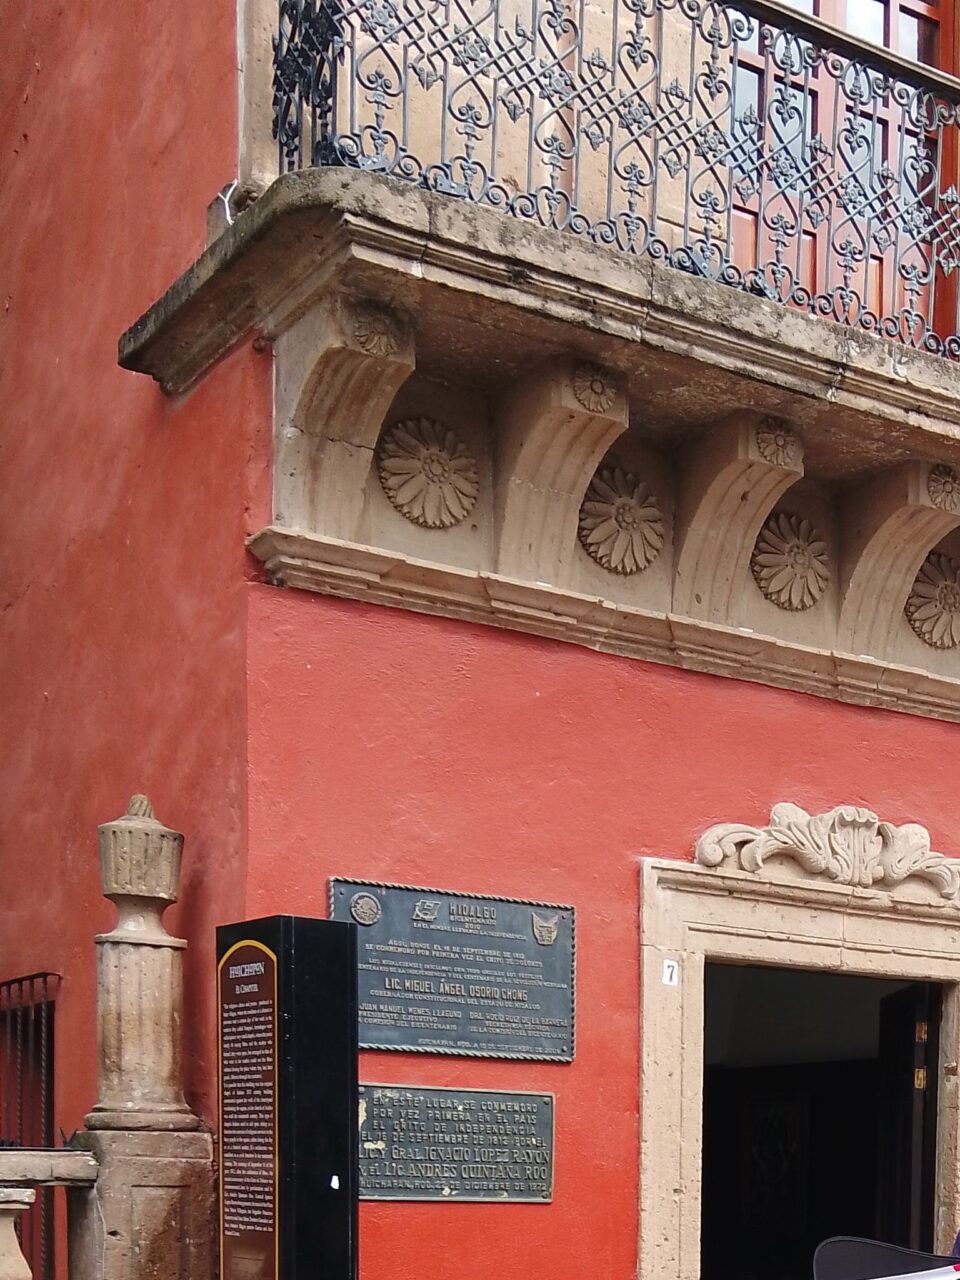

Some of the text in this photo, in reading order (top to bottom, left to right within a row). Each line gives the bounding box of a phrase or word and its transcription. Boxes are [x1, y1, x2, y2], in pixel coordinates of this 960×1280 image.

[449, 902, 497, 918] HIDALGO
[450, 915, 496, 926] BICENTENARIO
[417, 948, 430, 956] POR
[432, 950, 460, 959] PRIMERA
[667, 965, 675, 982] 7
[385, 978, 528, 1001] LIC. MIGUEL ÁNGEL OSORIO CHONG
[358, 1011, 399, 1020] PRESIDENTE
[360, 1002, 378, 1010] JUAN
[380, 1004, 406, 1014] MANUEL
[373, 1097, 385, 1106] EN
[394, 1098, 419, 1107] ESTE
[426, 1099, 458, 1108] LUGAR
[464, 1100, 476, 1110] SE
[373, 1108, 537, 1124] POR VEZ PRIMERA EN EL PAIS
[373, 1120, 537, 1135] EL GRITO DE INDEPENDENCIA
[361, 1132, 372, 1140] EL
[377, 1132, 387, 1140] 16
[392, 1132, 404, 1142] DE
[409, 1133, 469, 1144] SEPTIEMBRE
[473, 1136, 485, 1144] DE
[514, 1137, 532, 1146] POR
[536, 1138, 547, 1147] EL
[424, 1146, 470, 1161] IGNACIO
[474, 1148, 509, 1162] LOPEZ
[512, 1150, 550, 1164] RAYON
[409, 1164, 458, 1177] ANDRES
[462, 1164, 520, 1179] QUINTANA
[524, 1166, 548, 1180] ROO
[449, 1181, 460, 1189] DE
[464, 1182, 510, 1190] DICIEMBRE
[514, 1182, 525, 1191] DE
